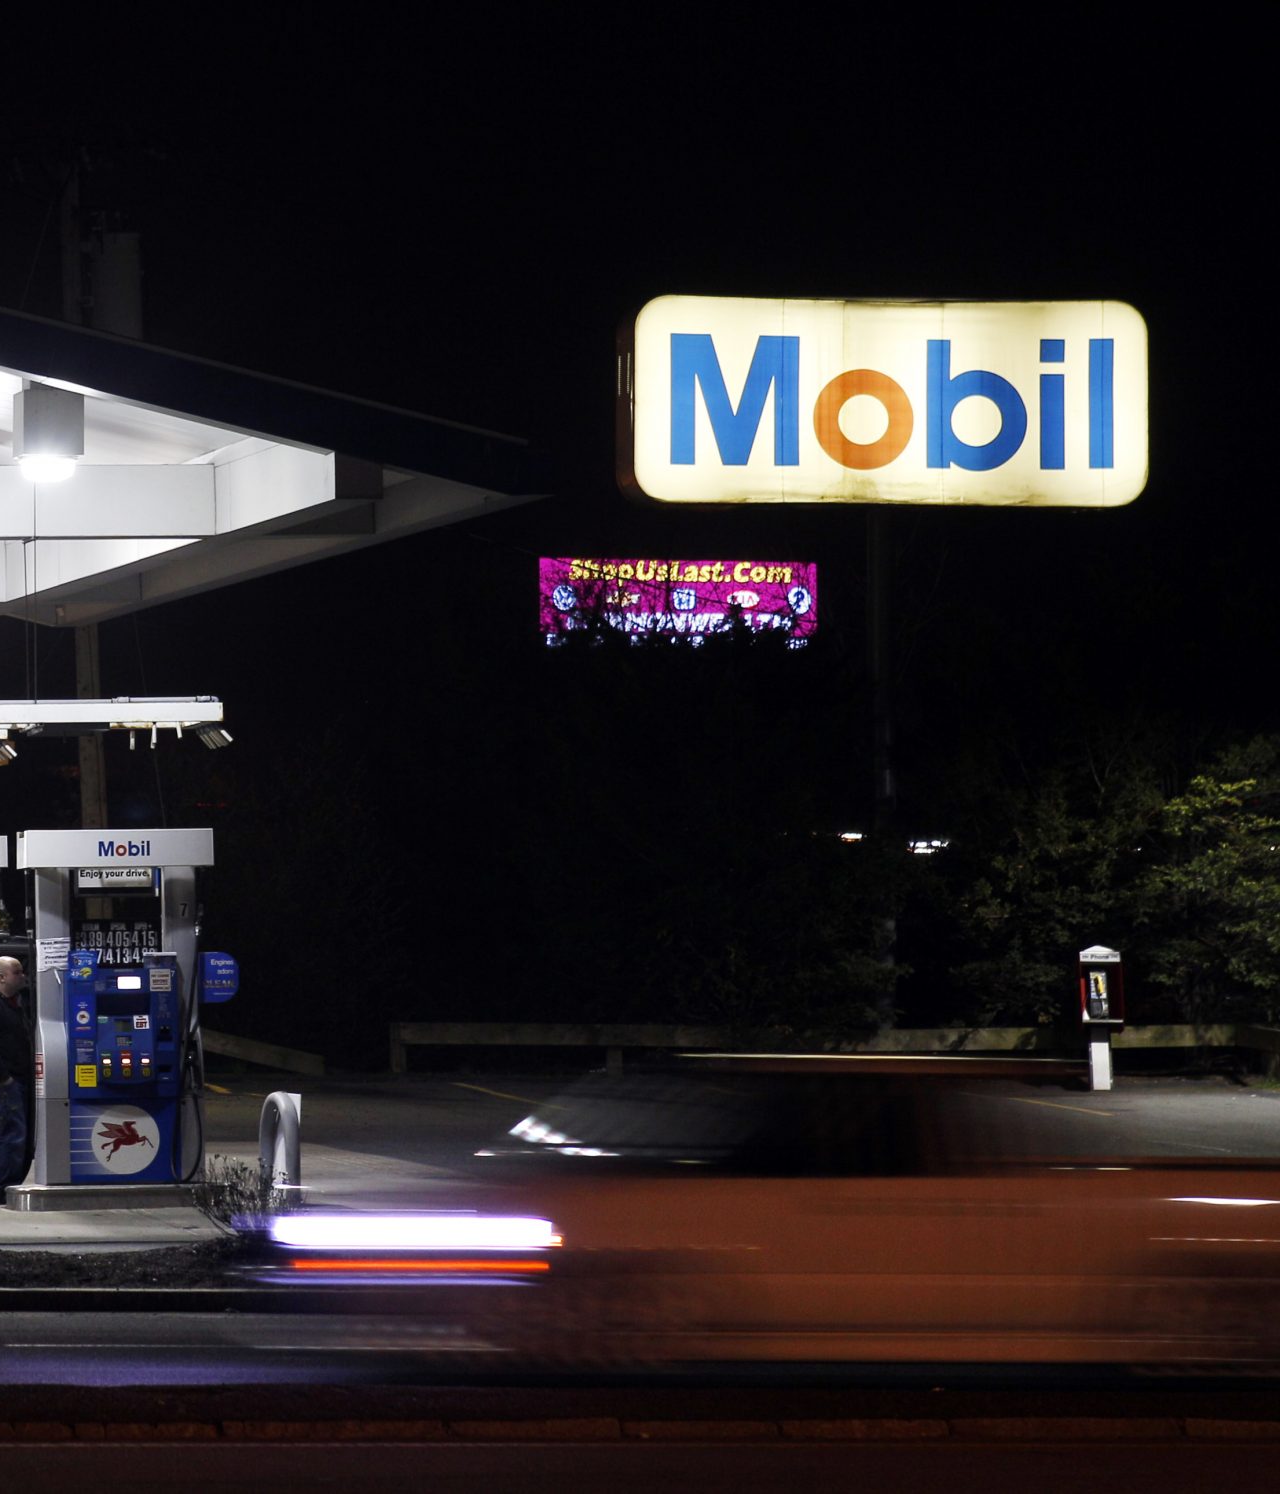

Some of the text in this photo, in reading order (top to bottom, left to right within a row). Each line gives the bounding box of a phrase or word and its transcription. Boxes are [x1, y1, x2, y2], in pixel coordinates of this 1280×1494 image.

[670, 332, 1114, 471] Mobil
[98, 841, 151, 857] Mobil
[79, 869, 104, 879] Enjoy
[105, 870, 124, 878] your
[180, 903, 187, 916] 7
